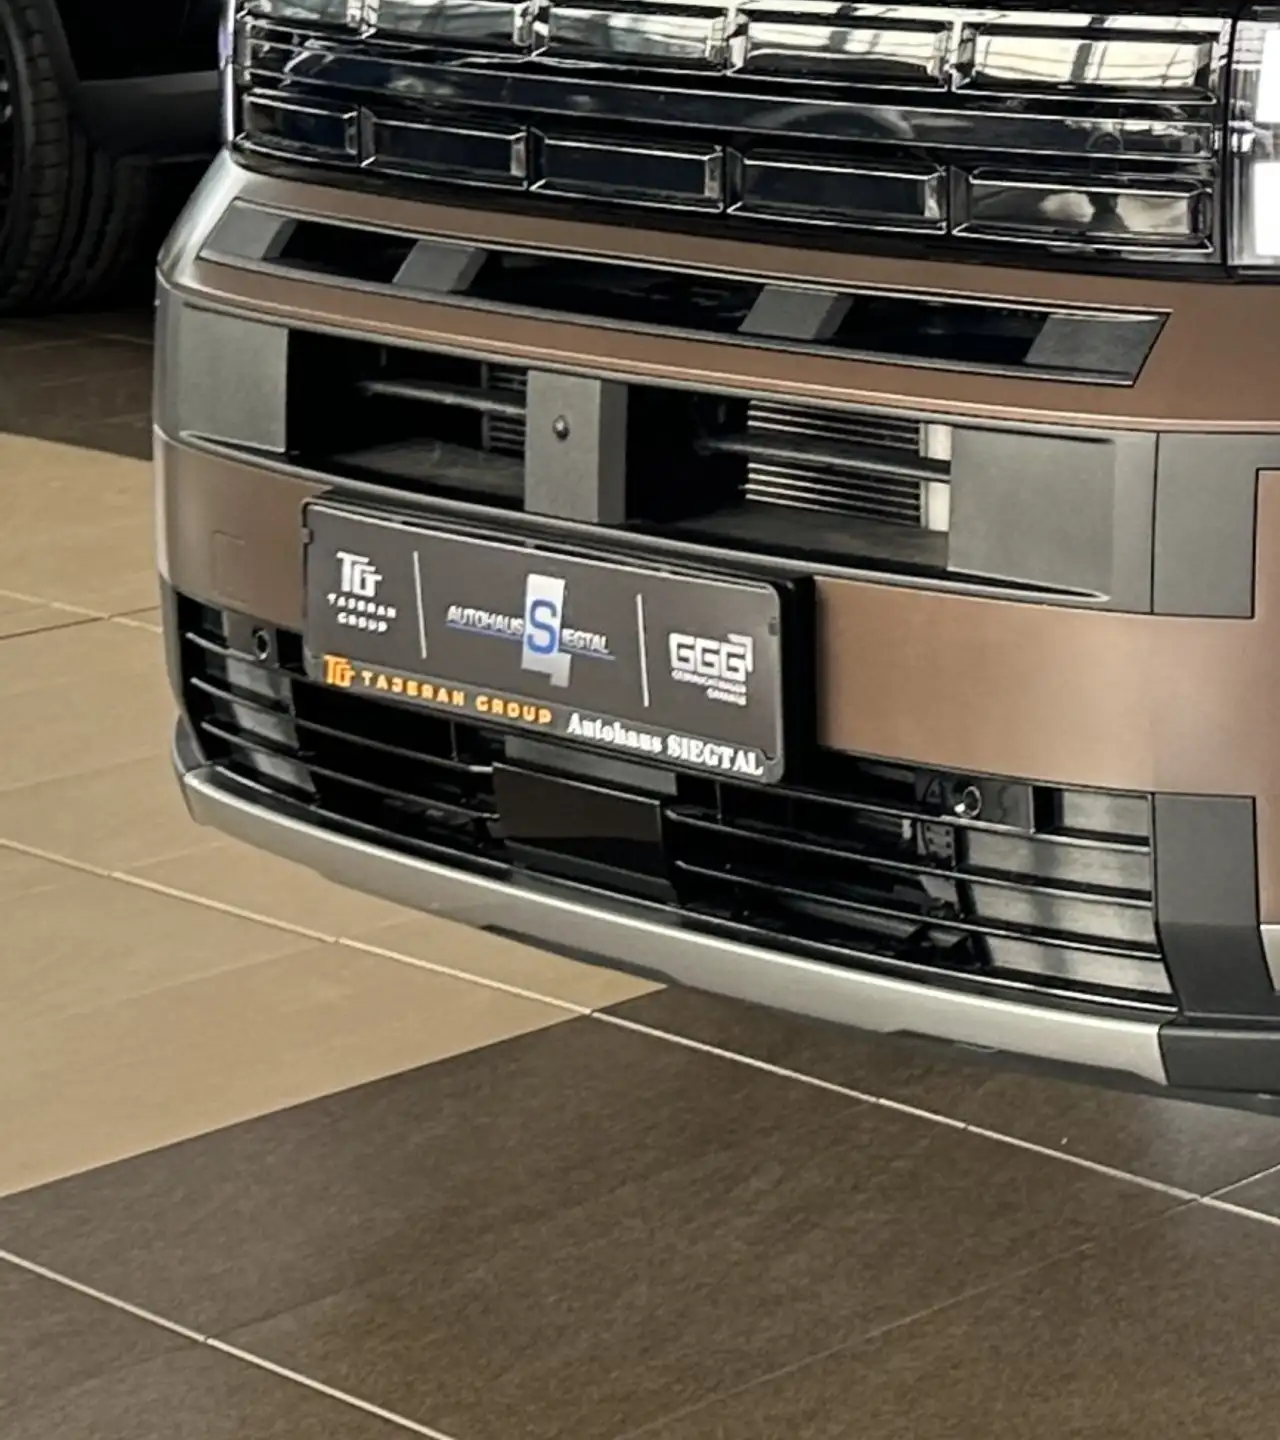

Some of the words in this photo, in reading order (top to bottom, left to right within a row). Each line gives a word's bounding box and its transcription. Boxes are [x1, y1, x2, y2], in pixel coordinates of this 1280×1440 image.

[447, 604, 525, 635] AUTOHAUS
[475, 695, 552, 724] GROUP
[567, 713, 663, 754] Autohaus
[667, 734, 764, 776] SIEGTAL
